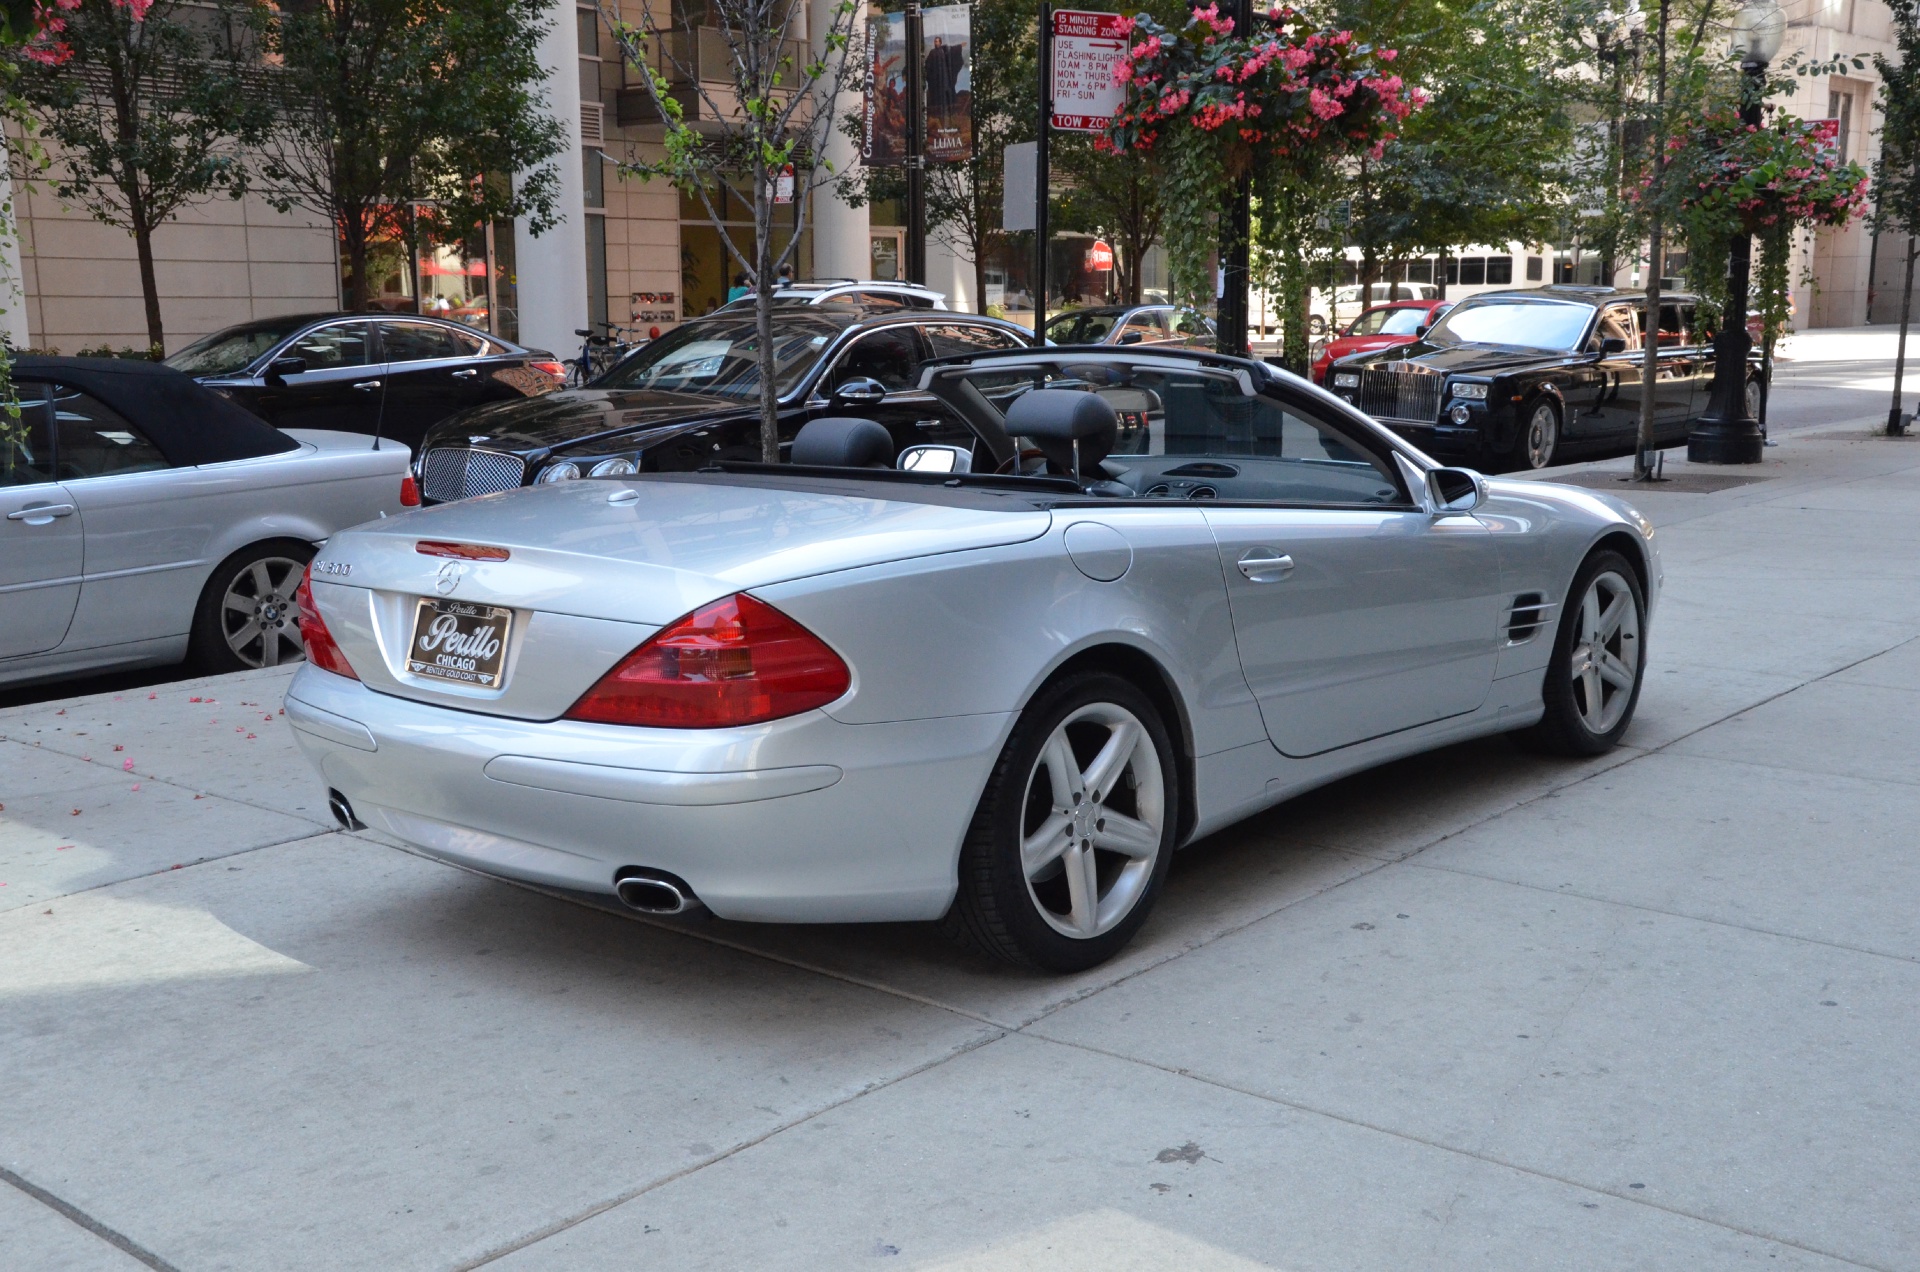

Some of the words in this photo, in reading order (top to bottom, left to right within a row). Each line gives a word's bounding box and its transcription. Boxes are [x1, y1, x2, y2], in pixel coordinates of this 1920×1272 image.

[1058, 14, 1066, 23] 15
[1070, 16, 1098, 26] MINUTE
[1058, 25, 1096, 36] STANDING
[1058, 41, 1074, 49] USE
[866, 23, 878, 84] Dwellings
[1057, 51, 1096, 60] FLASHING
[1098, 53, 1125, 62] LIGHTS
[1057, 61, 1066, 69] 10
[1068, 61, 1080, 70] AM
[1096, 63, 1108, 71] PM
[1057, 70, 1076, 79] MON
[1085, 72, 1111, 81] THURS
[1068, 81, 1079, 89] AM
[1094, 82, 1106, 90] PM
[866, 86, 874, 98] &
[1057, 90, 1070, 98] FRI
[1078, 91, 1095, 100] SUN
[1057, 115, 1082, 127] TOW
[1088, 117, 1112, 128] ZON
[862, 101, 876, 158] Crossings
[933, 137, 962, 149] LUMA
[447, 602, 478, 615] Perillo
[419, 614, 500, 660] Perillo
[436, 654, 476, 671] CHICAGO
[425, 665, 446, 676] BENTLEY
[446, 669, 460, 679] GOLD
[460, 672, 476, 681] COAST
